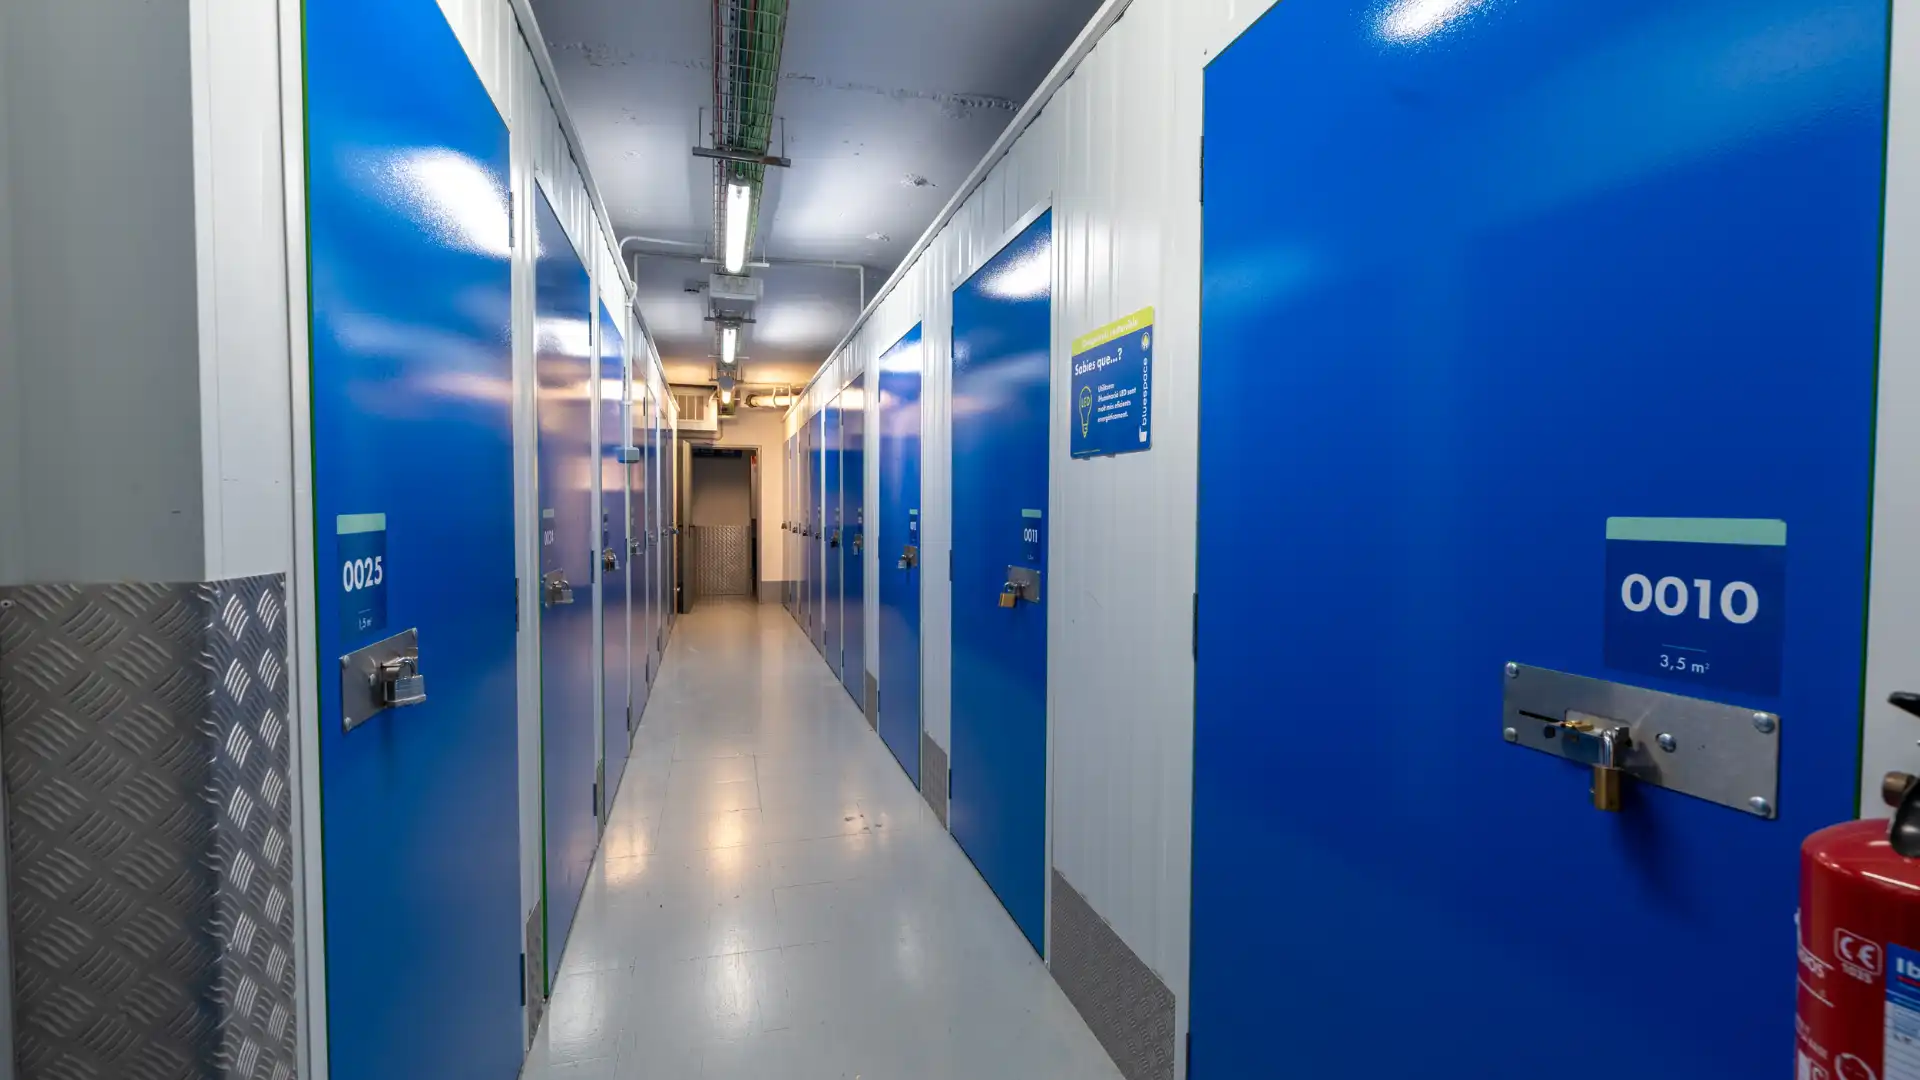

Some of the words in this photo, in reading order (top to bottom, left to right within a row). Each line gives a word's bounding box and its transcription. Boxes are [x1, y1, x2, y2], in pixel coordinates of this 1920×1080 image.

[1075, 360, 1096, 376] Sabies
[1097, 347, 1123, 371] que...?
[1081, 396, 1091, 408] LED
[1141, 357, 1149, 426] bluespace
[1023, 527, 1038, 543] 0011
[343, 556, 383, 592] 0025
[1621, 573, 1760, 624] 0010
[1660, 654, 1687, 672] 3,5
[1840, 936, 1876, 970] CE
